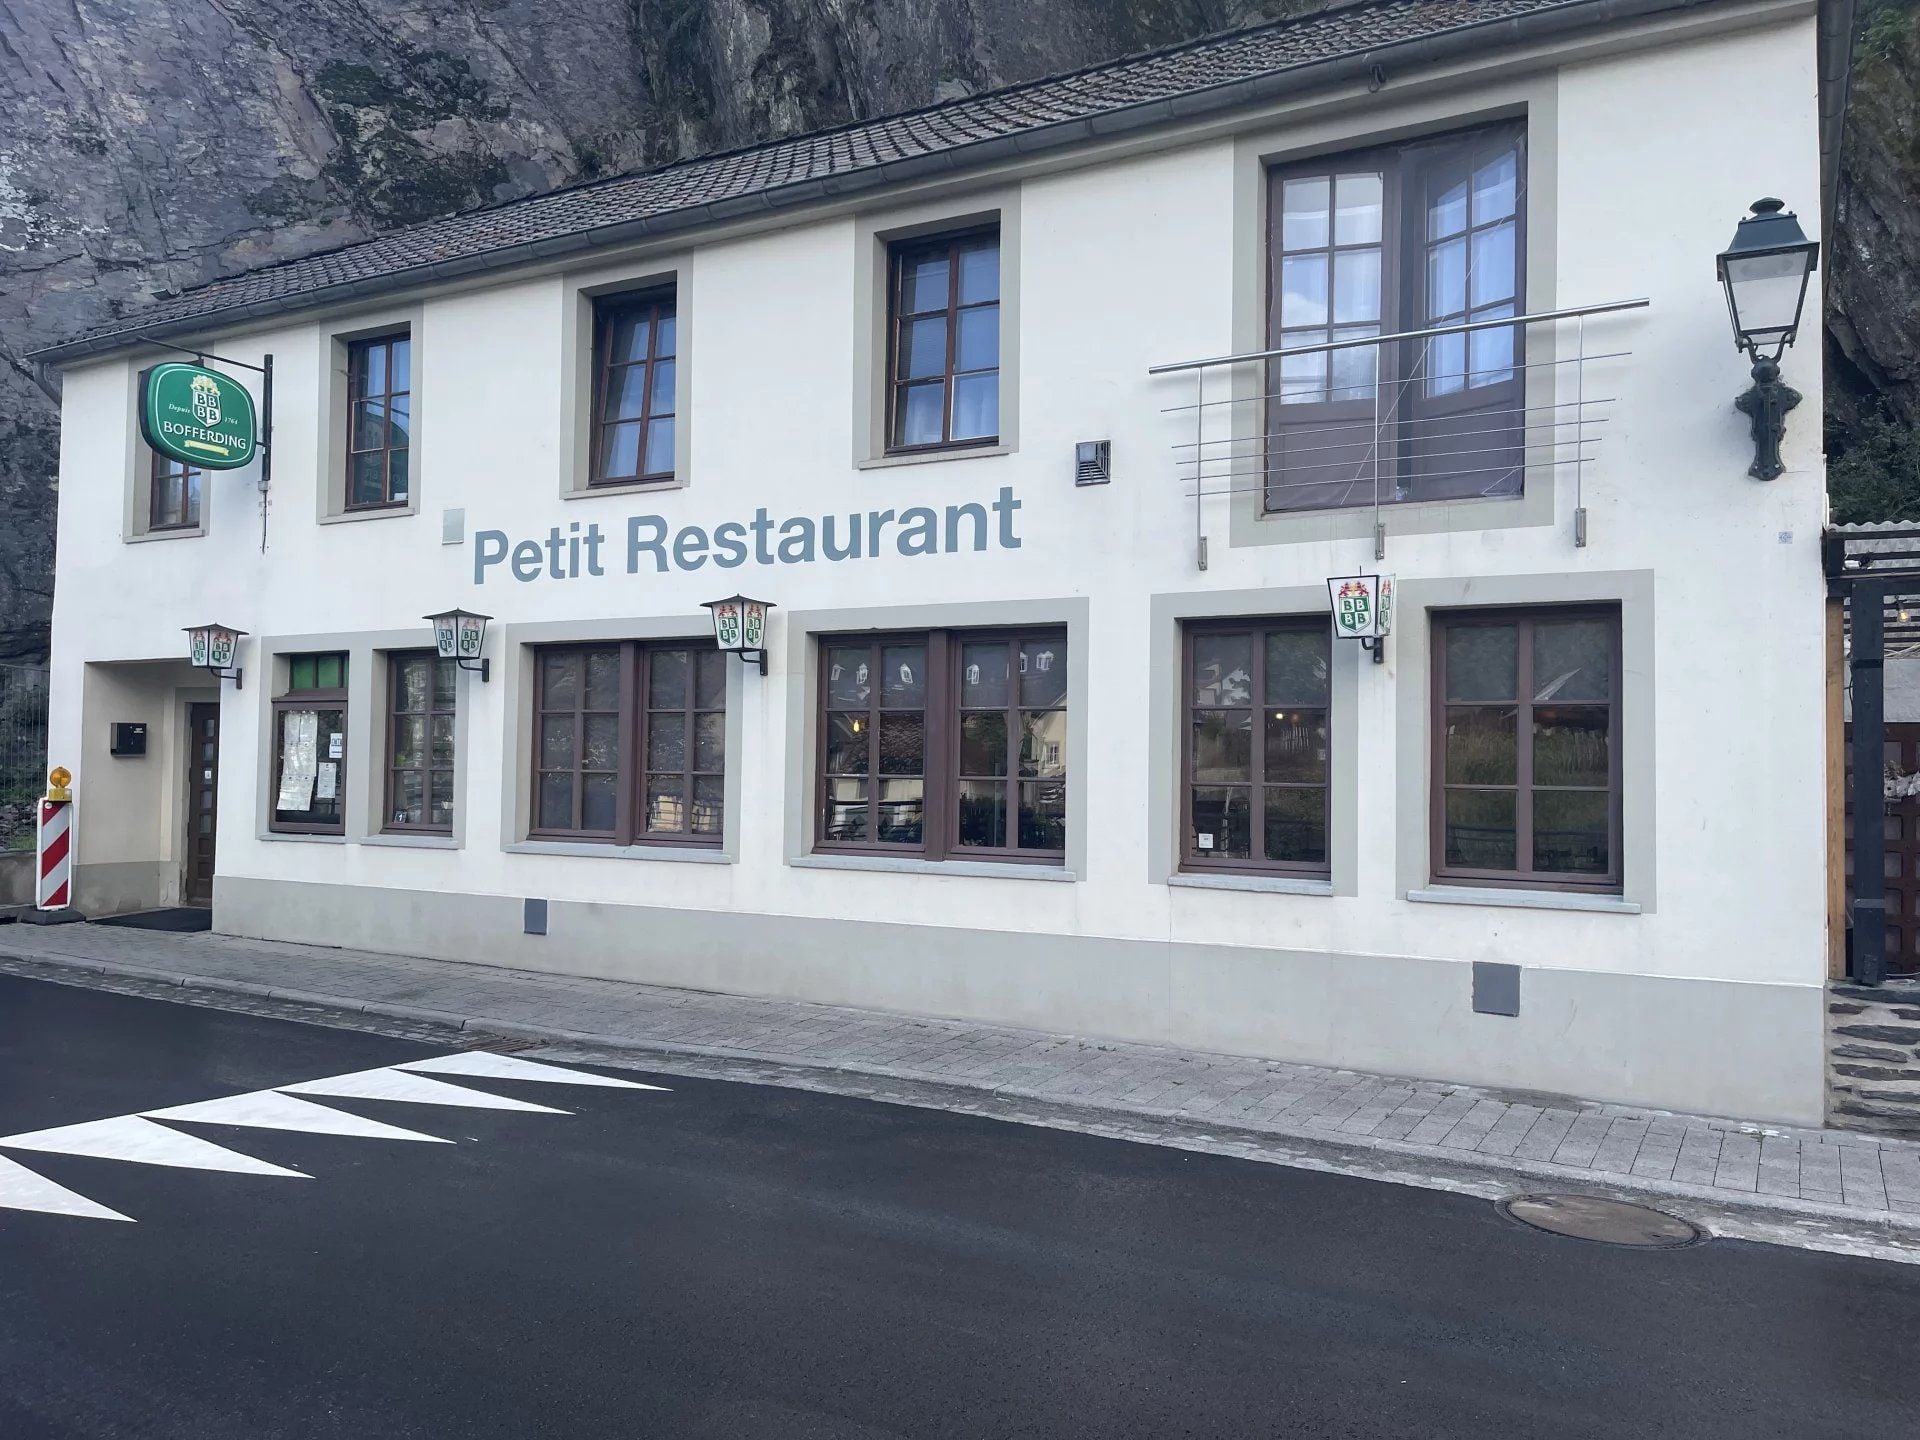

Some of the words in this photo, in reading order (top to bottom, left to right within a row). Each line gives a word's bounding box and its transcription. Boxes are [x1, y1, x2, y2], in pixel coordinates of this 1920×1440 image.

[163, 420, 246, 450] BOFFERDING
[474, 521, 605, 585] Petit
[626, 486, 1022, 574] Restaurant
